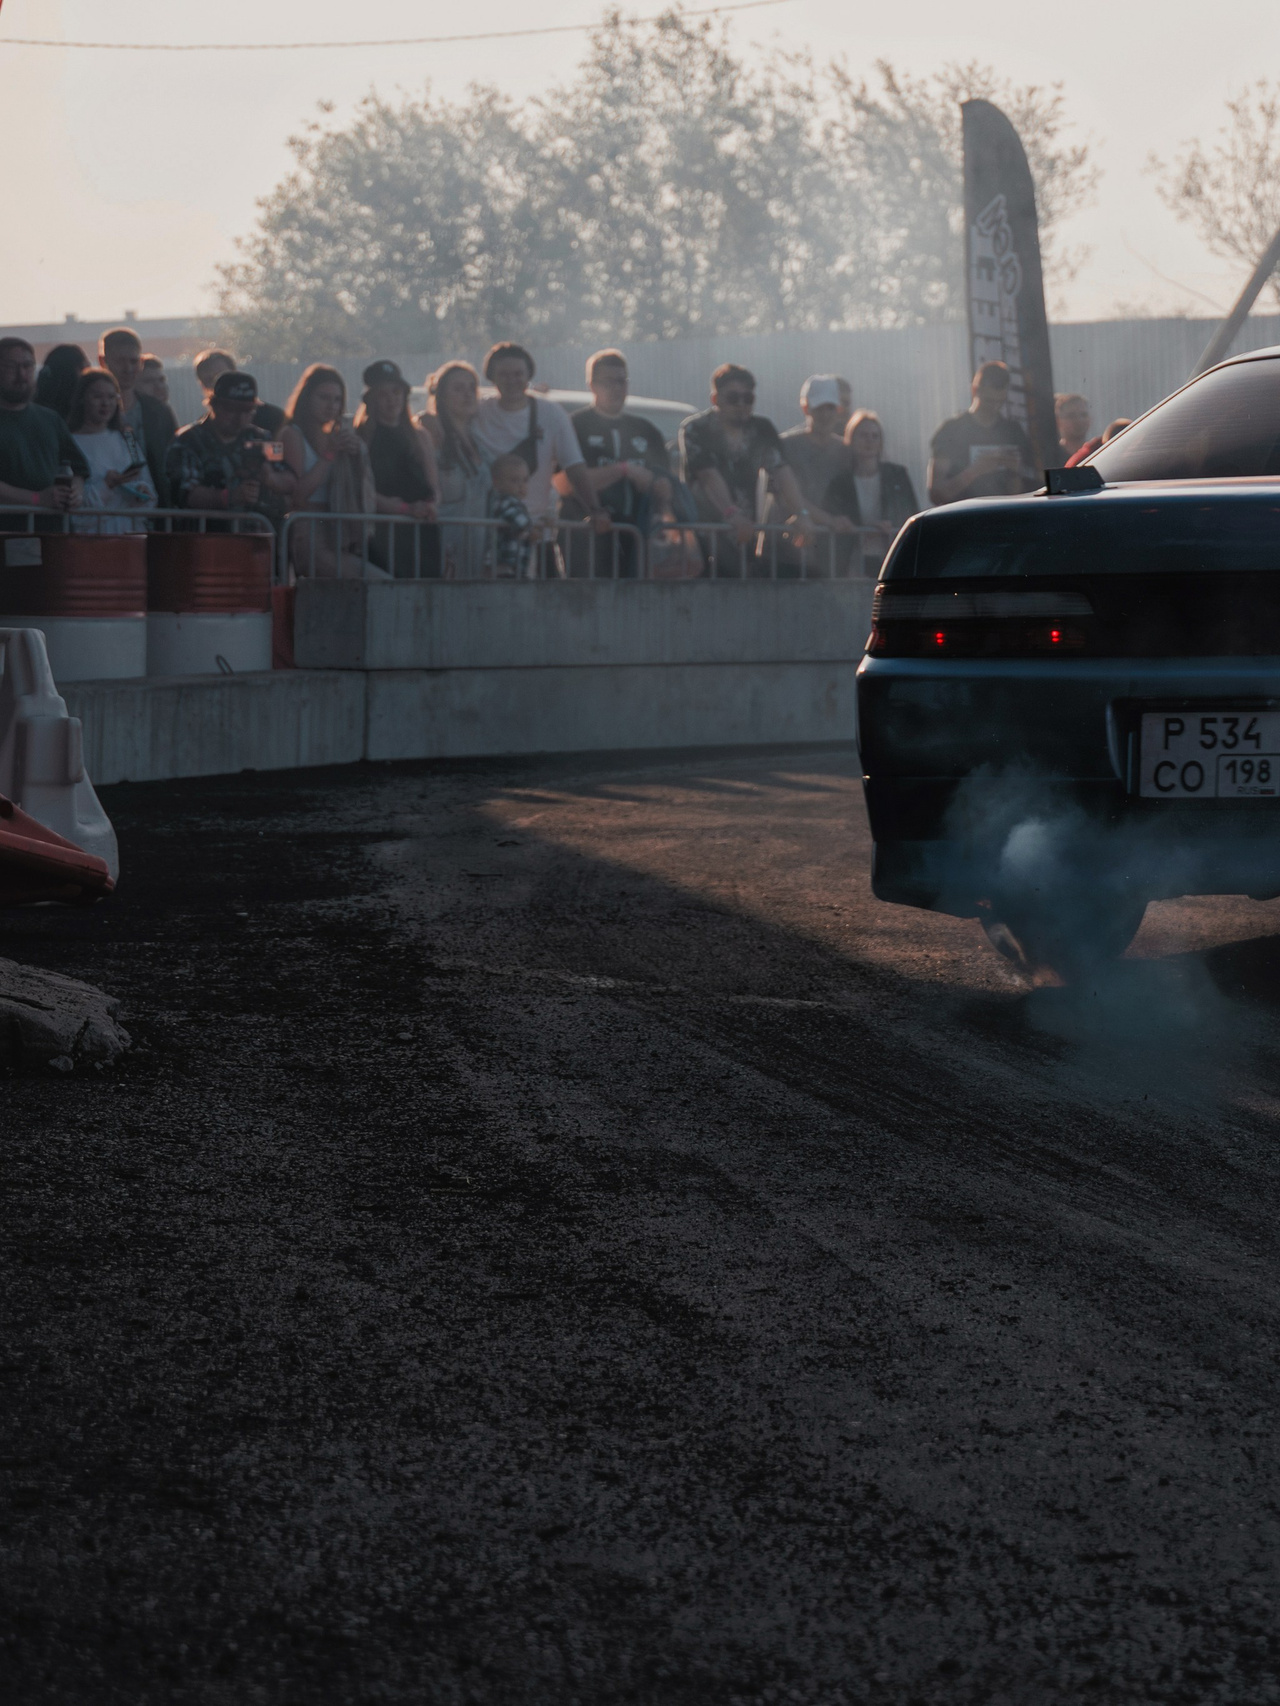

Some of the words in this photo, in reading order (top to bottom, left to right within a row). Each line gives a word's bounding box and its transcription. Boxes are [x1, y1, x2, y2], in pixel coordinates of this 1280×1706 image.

[1164, 717, 1185, 750] P
[1200, 717, 1261, 750] 534
[1153, 760, 1204, 792] CO
[1225, 759, 1271, 784] 198
